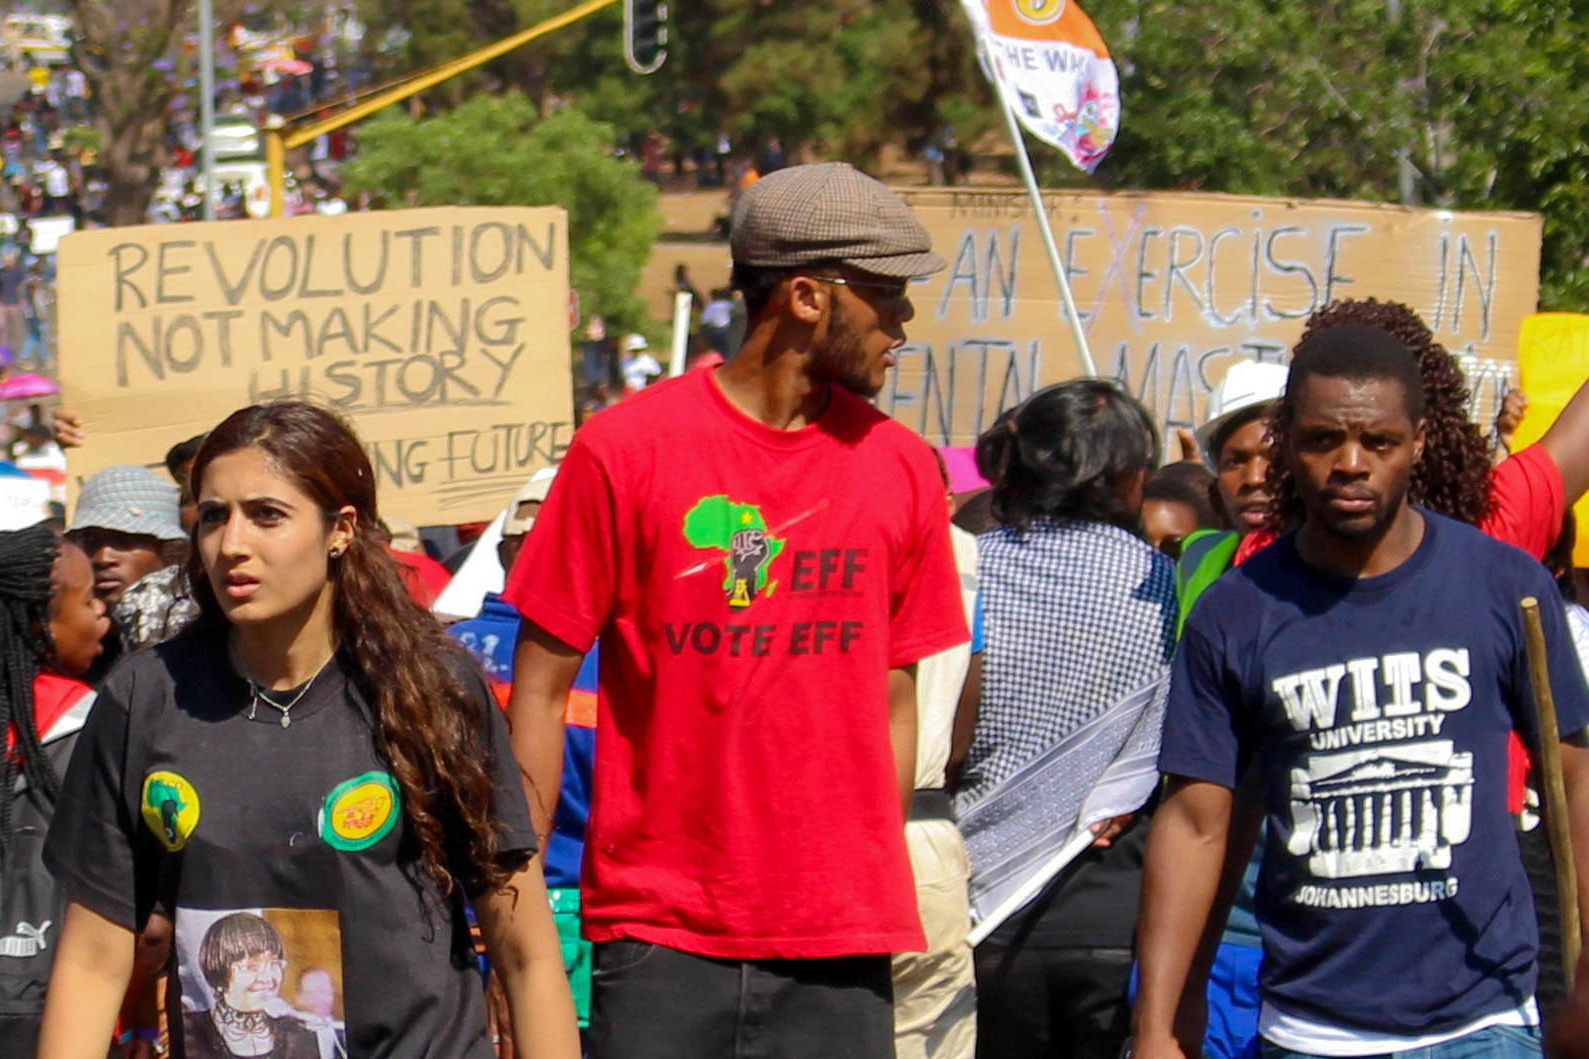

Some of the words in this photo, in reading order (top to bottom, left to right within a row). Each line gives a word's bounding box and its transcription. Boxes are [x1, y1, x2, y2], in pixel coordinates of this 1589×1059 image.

[109, 222, 556, 312] REVOLUTION
[935, 224, 1021, 324] AN
[117, 310, 244, 388] NOT
[259, 296, 527, 361] MAKING
[248, 343, 525, 404] HISTORY
[438, 421, 571, 481] FUTURE
[791, 548, 869, 592] EFF
[664, 621, 777, 657] VOTE
[788, 620, 865, 656] EFF
[1272, 648, 1472, 731] WITS
[1310, 714, 1446, 751] UNIVERSITY
[1294, 876, 1459, 909] JOHANNESBURG
